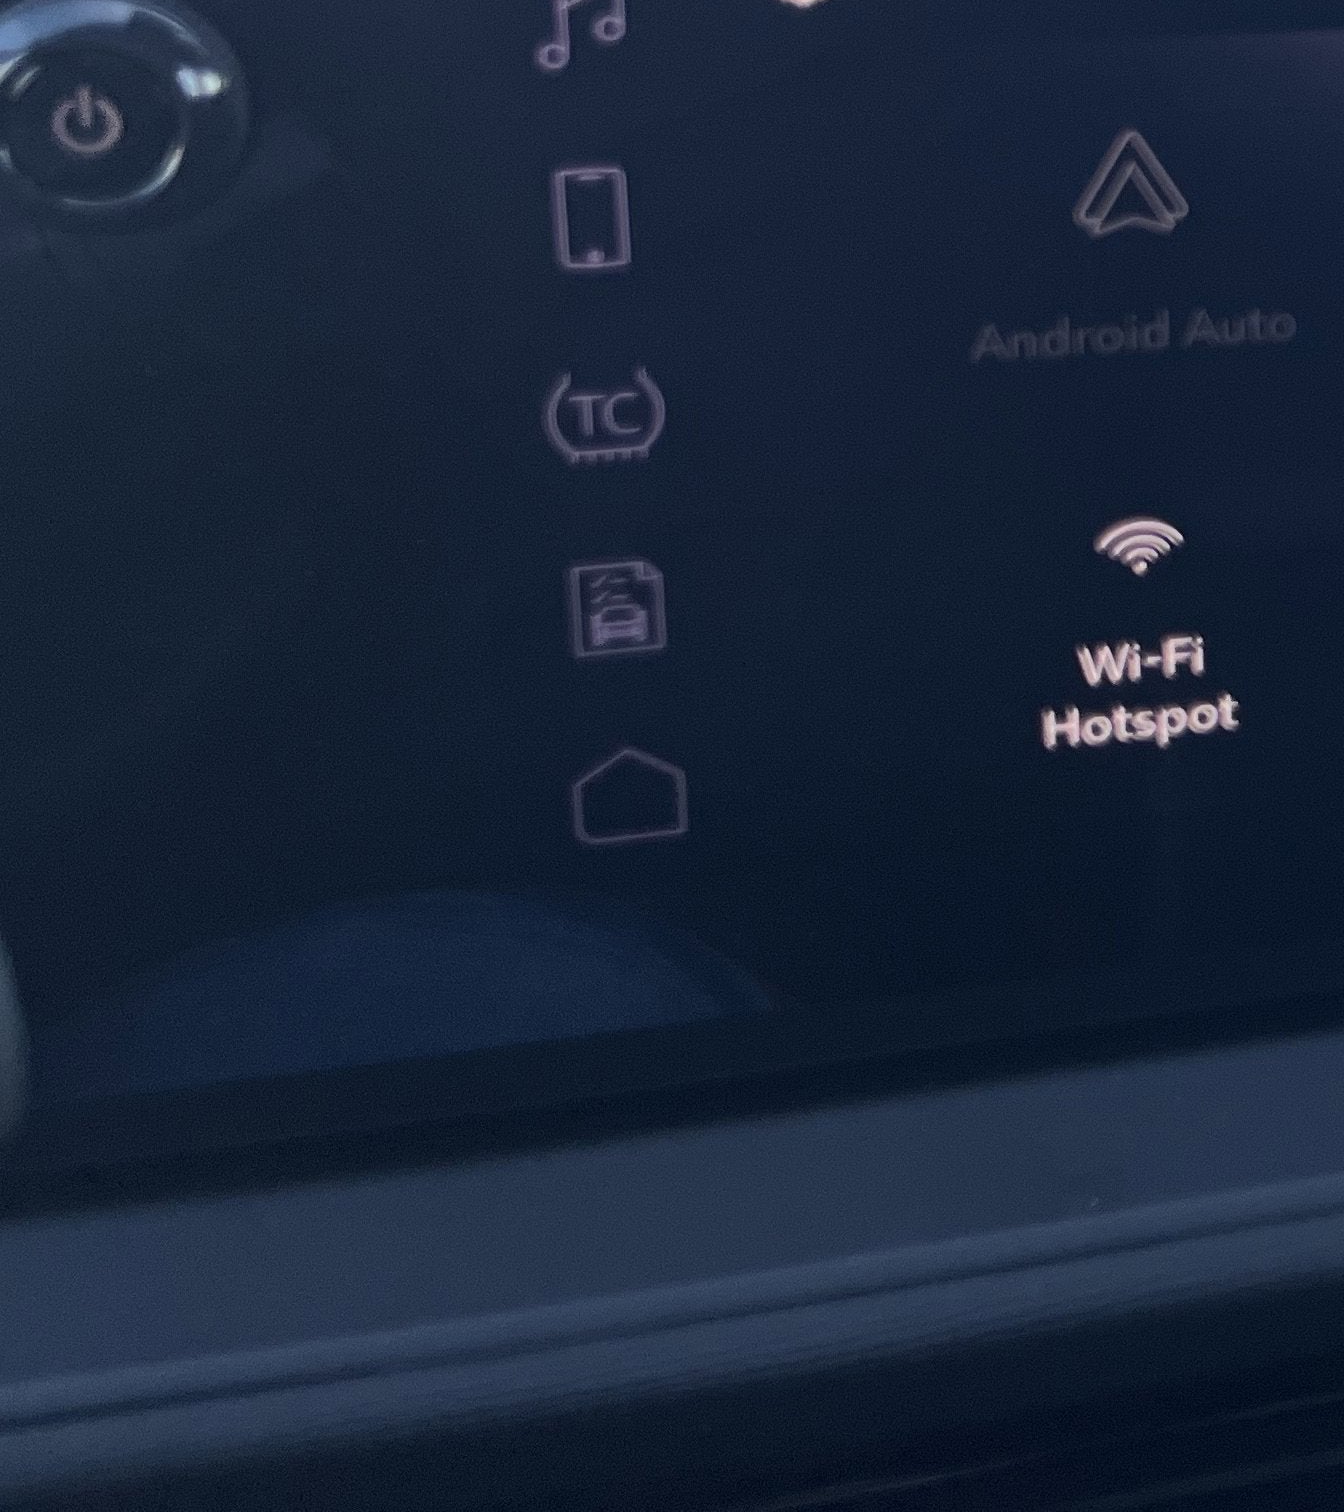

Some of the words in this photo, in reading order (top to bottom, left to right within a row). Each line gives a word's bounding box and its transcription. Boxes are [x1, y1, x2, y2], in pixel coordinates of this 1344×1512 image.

[970, 310, 1171, 364] Android
[1183, 307, 1298, 350] Auto
[568, 391, 640, 437] TC
[1077, 635, 1205, 687] Wi-Fi
[1042, 692, 1239, 750] Hotspot
